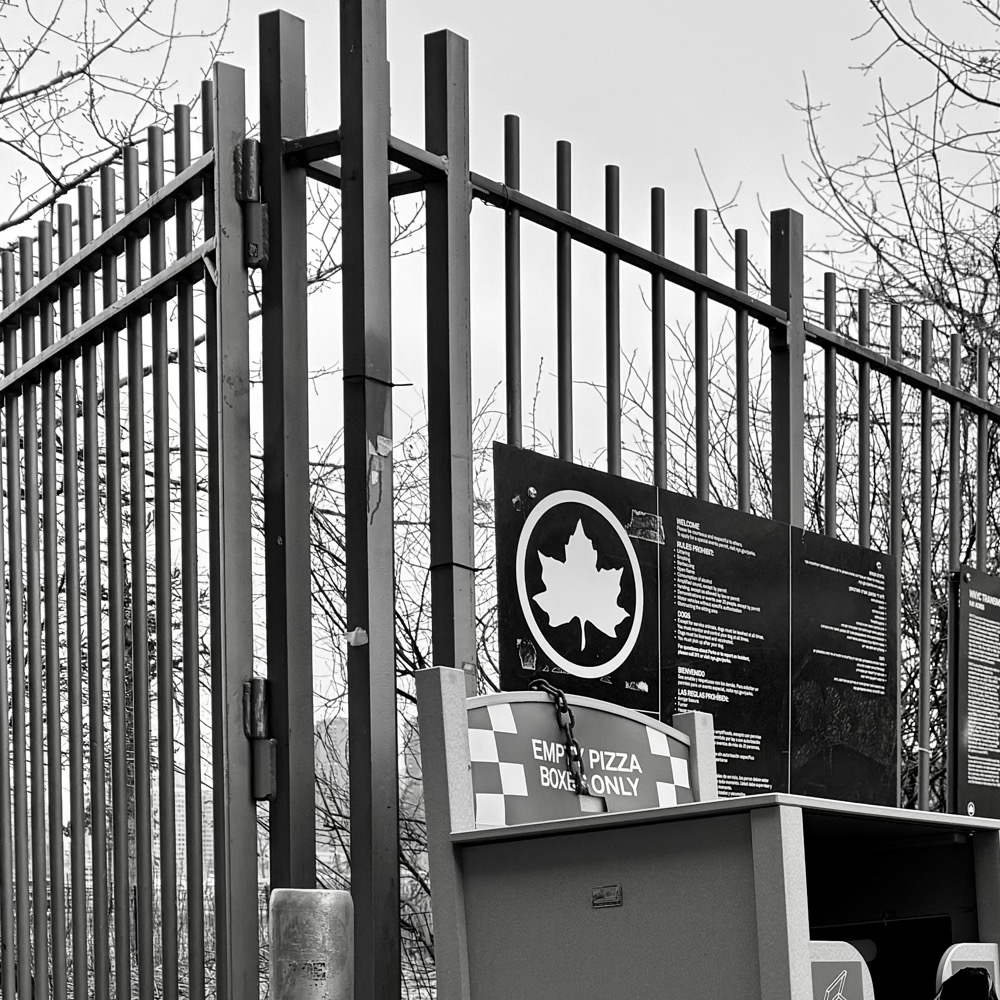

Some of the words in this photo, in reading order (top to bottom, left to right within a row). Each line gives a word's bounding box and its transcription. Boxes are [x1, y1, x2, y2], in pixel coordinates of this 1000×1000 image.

[676, 518, 700, 531] WELCOME
[677, 611, 691, 620] DOGS
[532, 739, 584, 768] EMPY
[589, 749, 643, 773] PIZZA
[591, 774, 639, 797] ONLY
